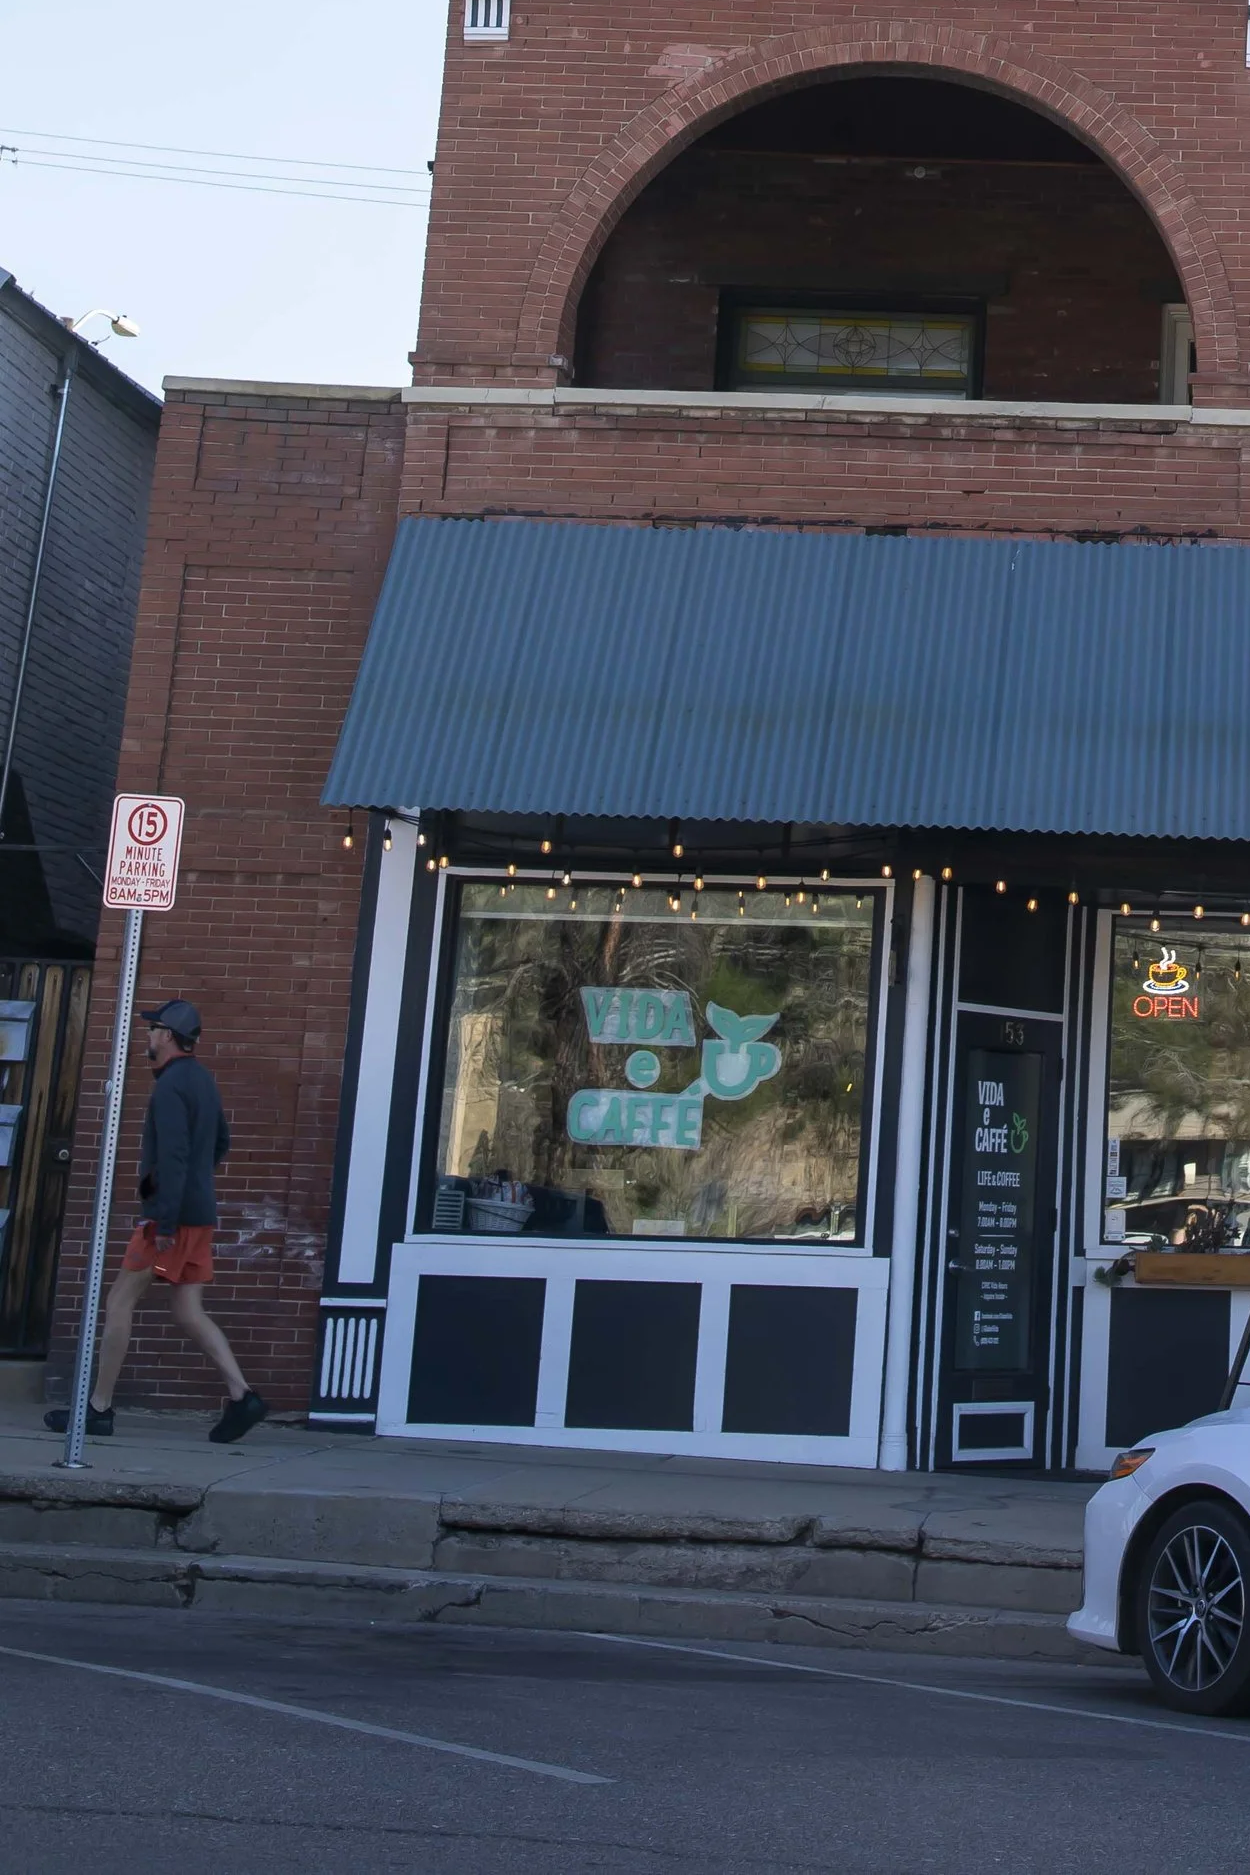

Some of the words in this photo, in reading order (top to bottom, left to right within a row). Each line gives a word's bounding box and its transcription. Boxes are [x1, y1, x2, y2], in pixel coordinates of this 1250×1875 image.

[138, 811, 158, 838] 15
[125, 846, 163, 862] MINUTE
[119, 861, 166, 877] PARKING
[585, 991, 690, 1040] VIDA
[1133, 996, 1199, 1018] OPEN
[630, 1053, 657, 1083] e
[978, 1080, 1004, 1106] VIDA
[983, 1107, 990, 1126] e
[975, 1124, 1008, 1153] CAFFÉ
